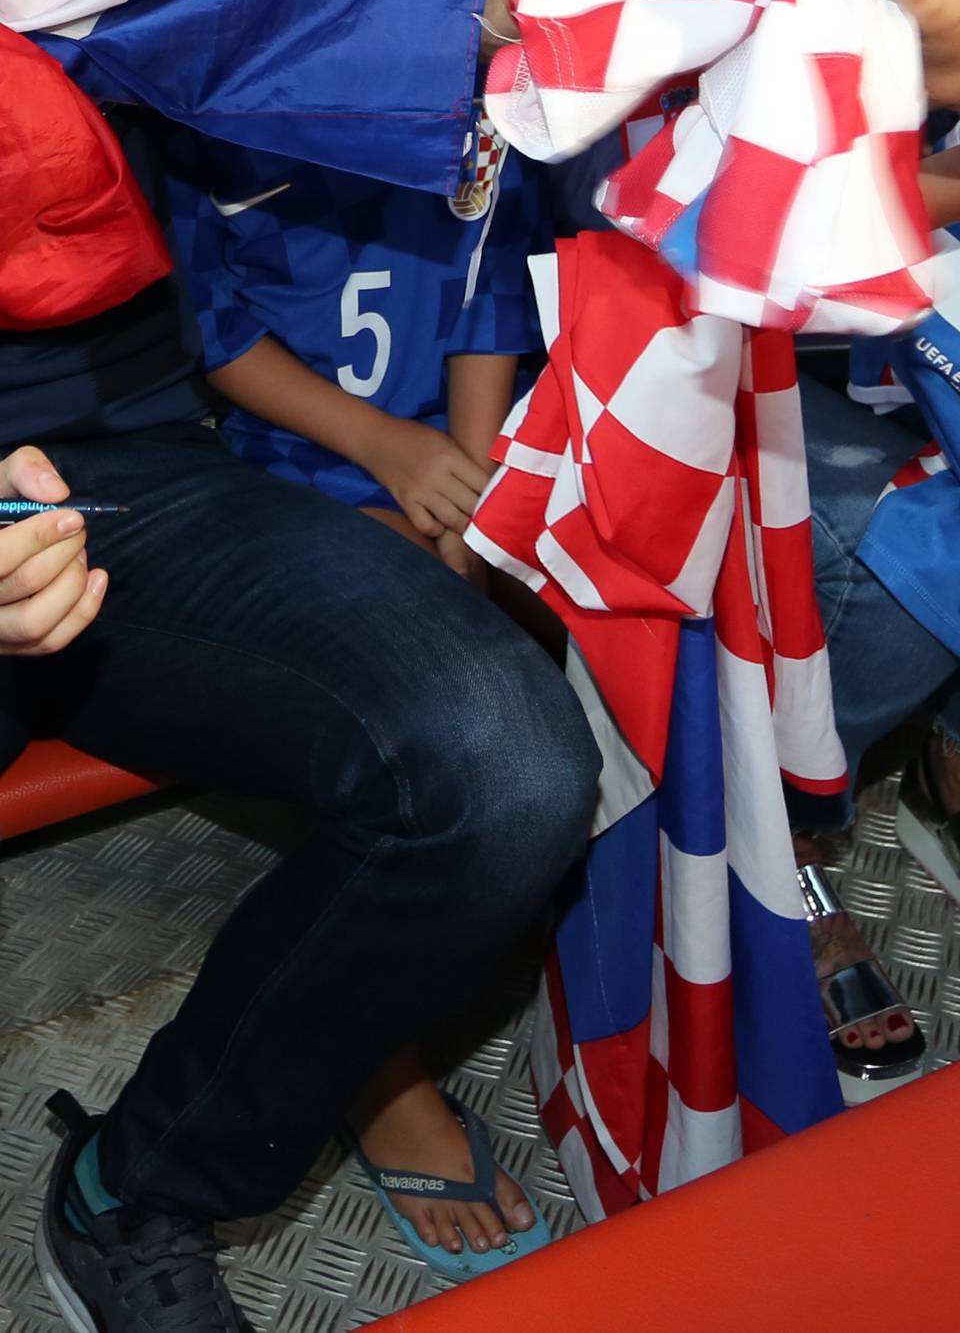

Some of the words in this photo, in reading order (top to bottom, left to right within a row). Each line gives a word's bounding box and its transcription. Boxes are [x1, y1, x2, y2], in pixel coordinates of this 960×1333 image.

[337, 270, 391, 398] 5
[915, 337, 954, 376] UEFA
[380, 1172, 446, 1191] havaianas
